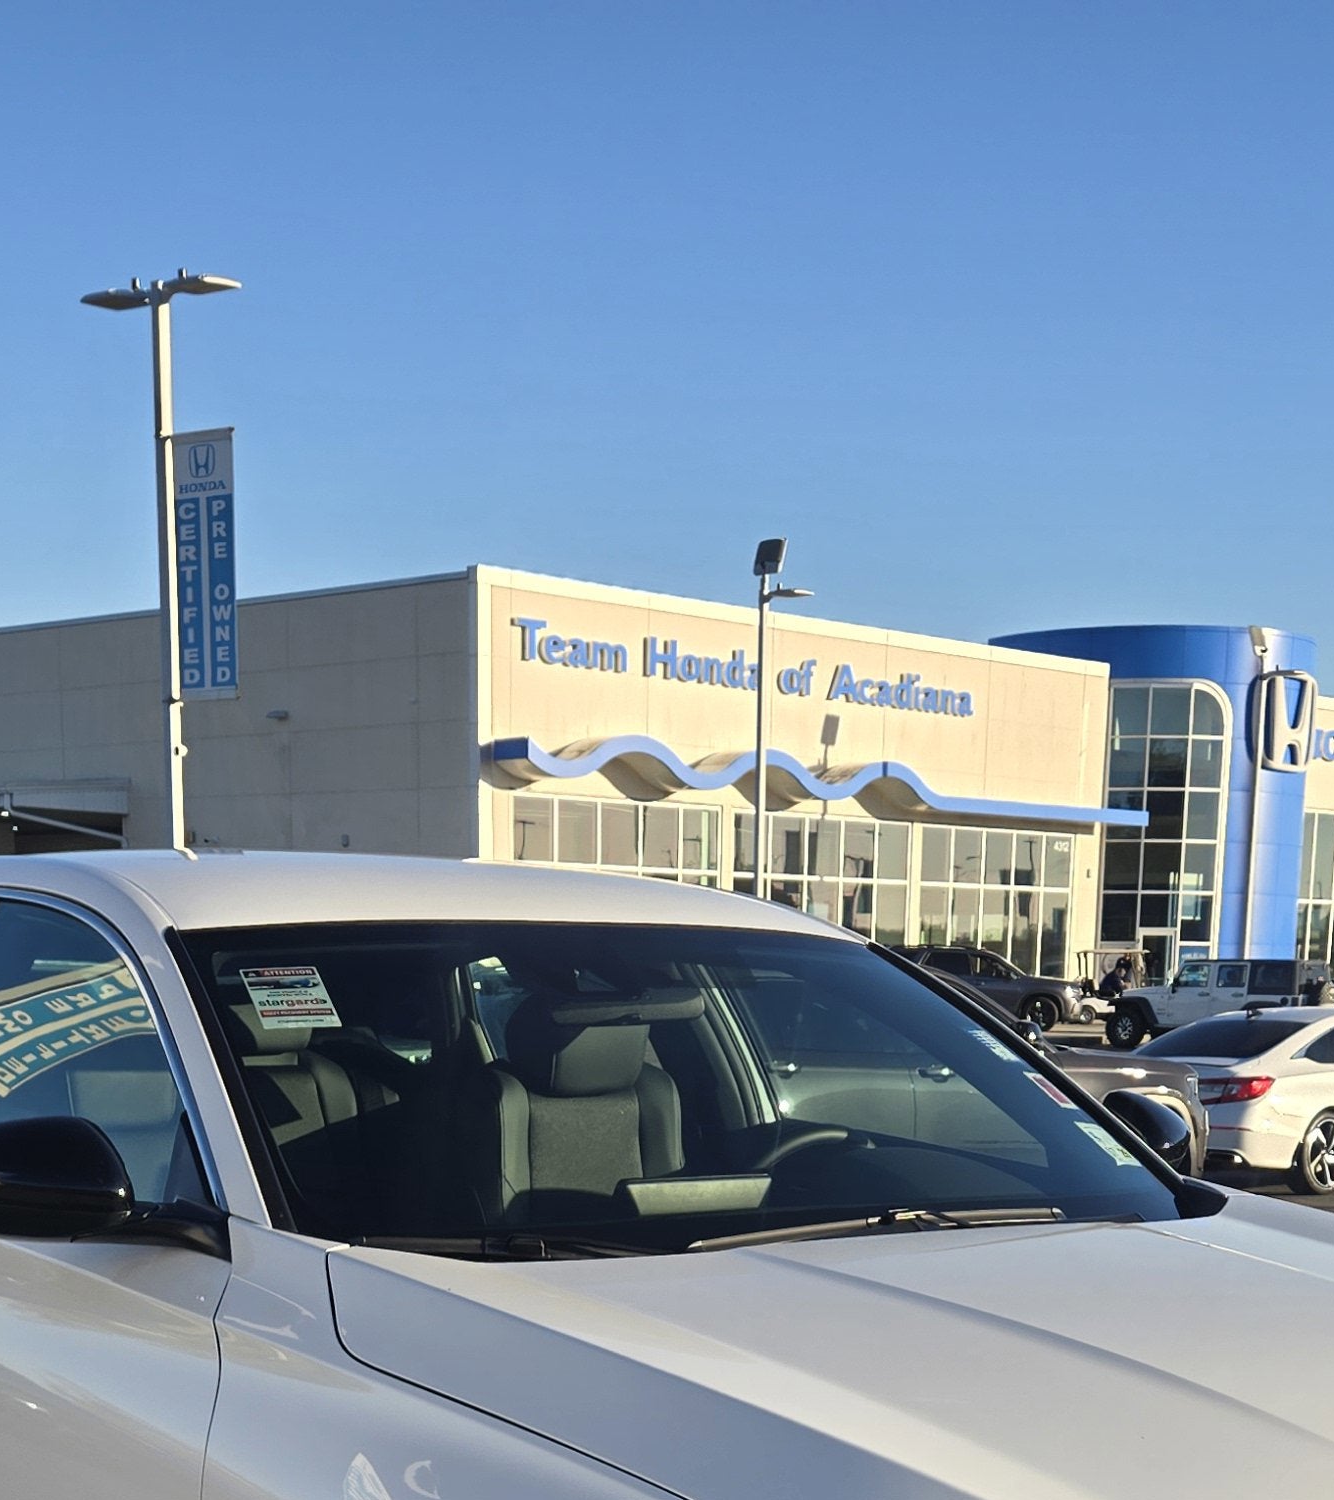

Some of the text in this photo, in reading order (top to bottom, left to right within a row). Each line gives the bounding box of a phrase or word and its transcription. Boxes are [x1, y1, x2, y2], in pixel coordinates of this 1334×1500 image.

[178, 481, 227, 494] HONDA
[178, 503, 201, 685] CERTIFIED
[212, 501, 233, 683] PRE OWNED
[511, 617, 974, 717] Team Honda of Acadiana
[263, 968, 313, 977] ATTENTION
